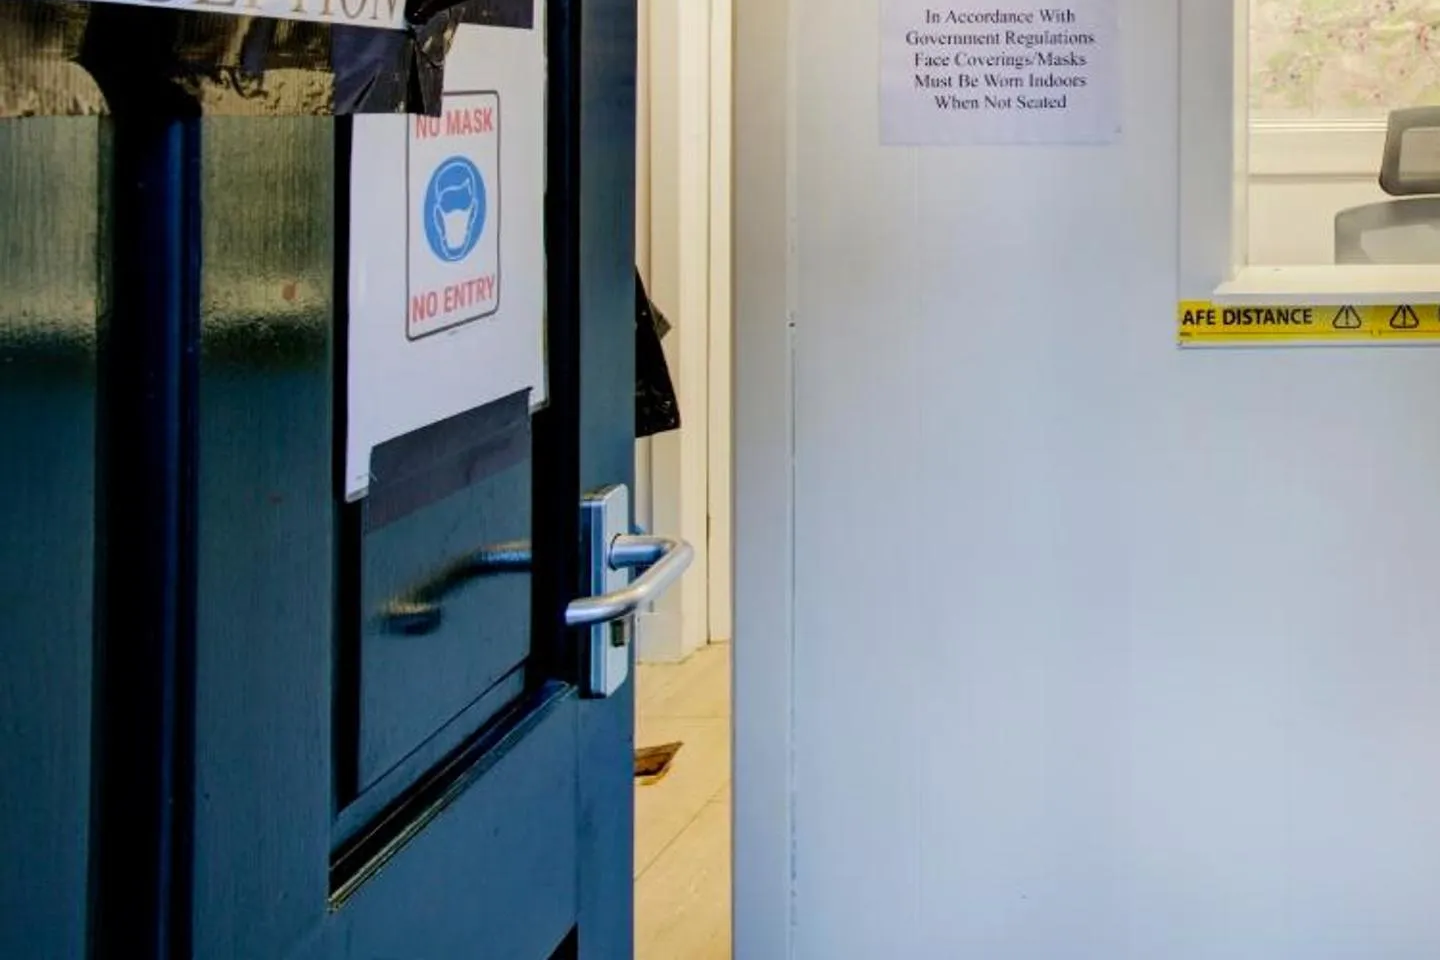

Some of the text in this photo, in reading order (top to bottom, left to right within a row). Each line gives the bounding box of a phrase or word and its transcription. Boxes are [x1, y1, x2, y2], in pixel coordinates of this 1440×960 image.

[925, 9, 1076, 24] In Accordance With
[905, 30, 1095, 48] Government Regulations
[914, 51, 1087, 69] Face Coverings/Masks
[914, 73, 1087, 89] Must Be Worn Indoors
[934, 95, 1067, 110] When Not Seated
[415, 107, 494, 139] NO MASK
[412, 275, 496, 323] NO ENTRY
[1182, 307, 1313, 326] AFE DISTANCE
